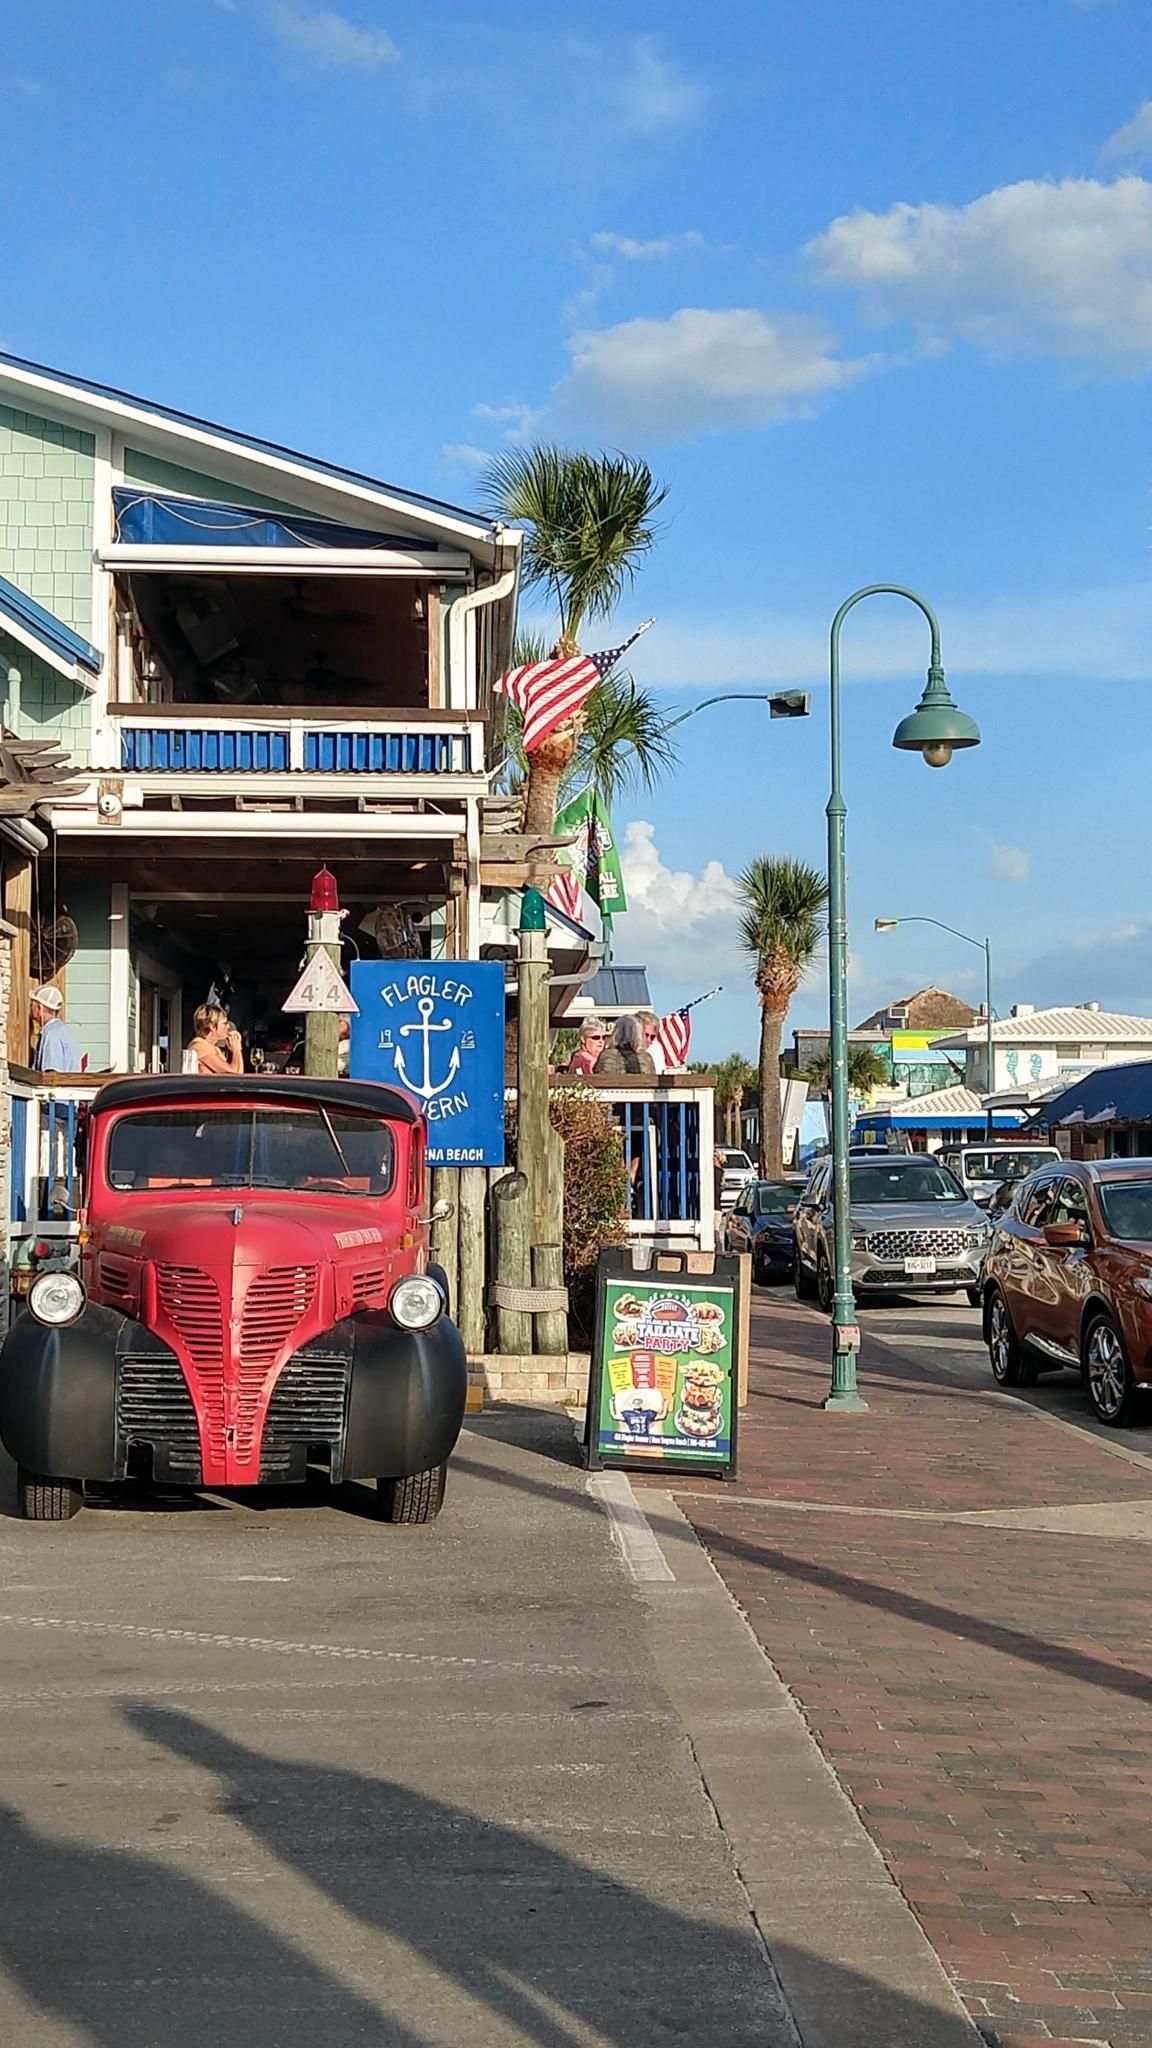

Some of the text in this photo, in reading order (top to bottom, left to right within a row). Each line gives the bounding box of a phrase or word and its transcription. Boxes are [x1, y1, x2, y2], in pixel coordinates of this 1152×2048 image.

[380, 975, 473, 1008] FLAGLER
[380, 1029, 392, 1043] 19
[446, 1148, 484, 1161] BEACH
[637, 1323, 700, 1343] TAILGATE
[645, 1336, 690, 1353] PARTY
